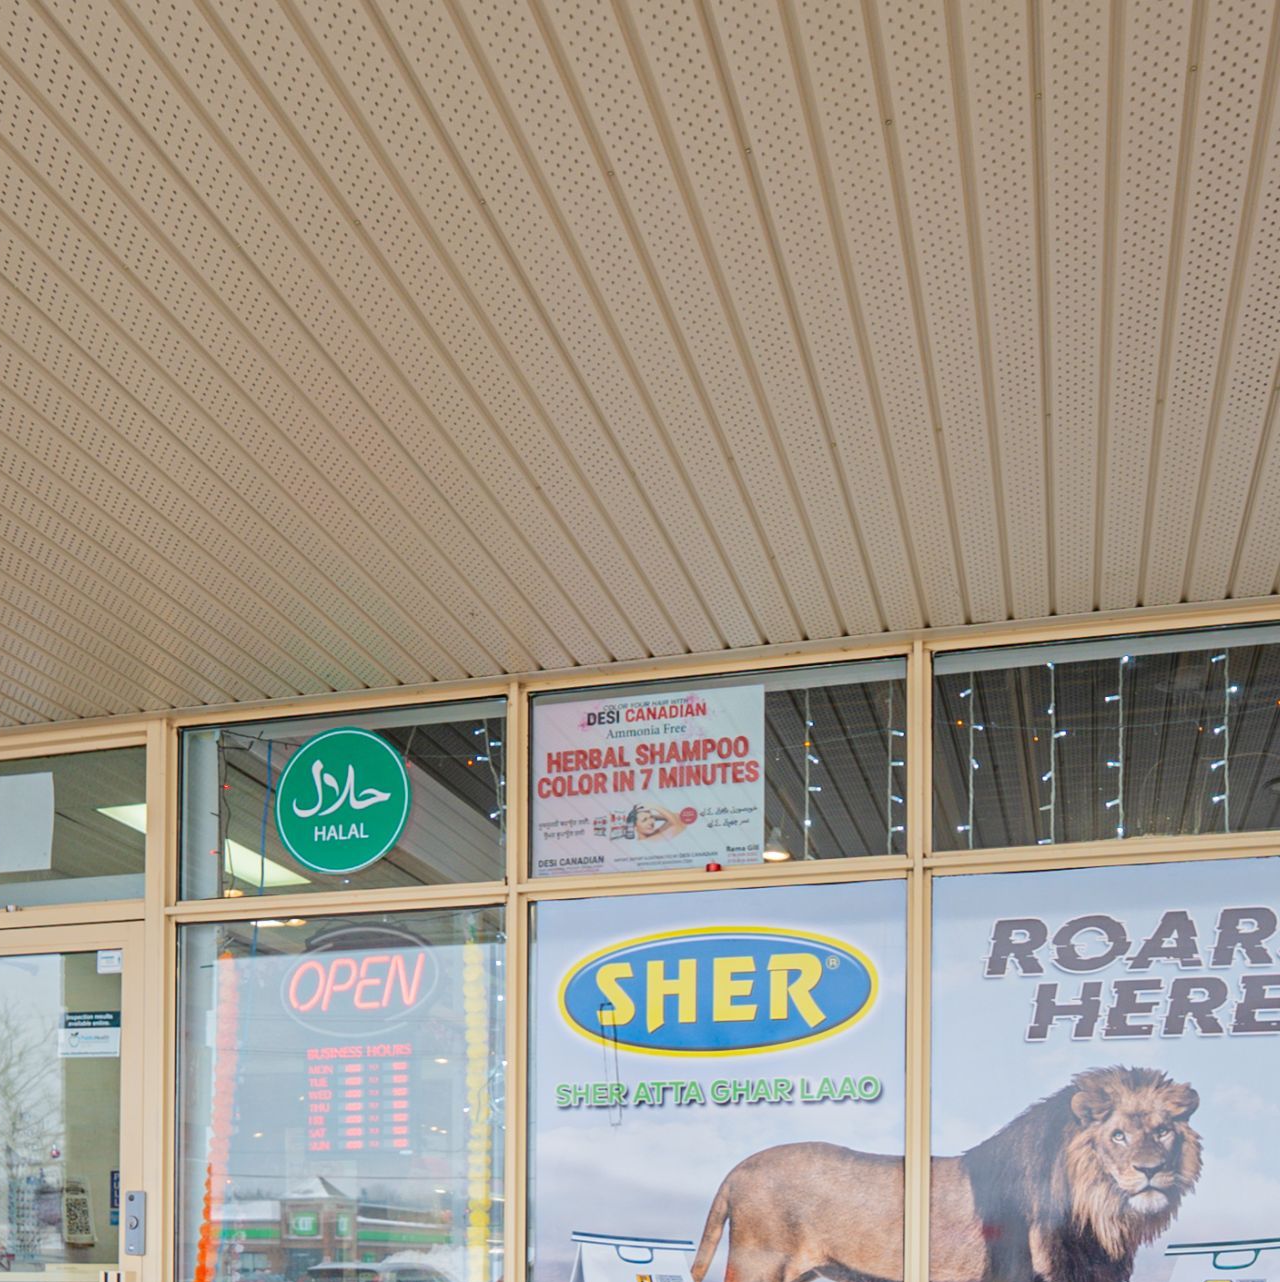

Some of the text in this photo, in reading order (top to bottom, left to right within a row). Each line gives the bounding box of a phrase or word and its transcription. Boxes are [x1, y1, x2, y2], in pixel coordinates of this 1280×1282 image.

[587, 703, 707, 726] DESI CANADIAN
[606, 723, 687, 740] Ammonia Free
[546, 735, 750, 774] HERBAL SHAMPOO
[292, 759, 392, 818] حلال
[537, 760, 760, 799] COLOR IN 7 MINUTES
[314, 822, 369, 842] HALAL
[538, 859, 558, 868] DESI
[559, 855, 605, 866] CANADIAN
[288, 952, 426, 1012] OPEN
[595, 952, 828, 1035] SHER
[306, 1043, 413, 1060] BUSINESS HOURS
[555, 1075, 884, 1107] SHER ATTA GHAR LAAO
